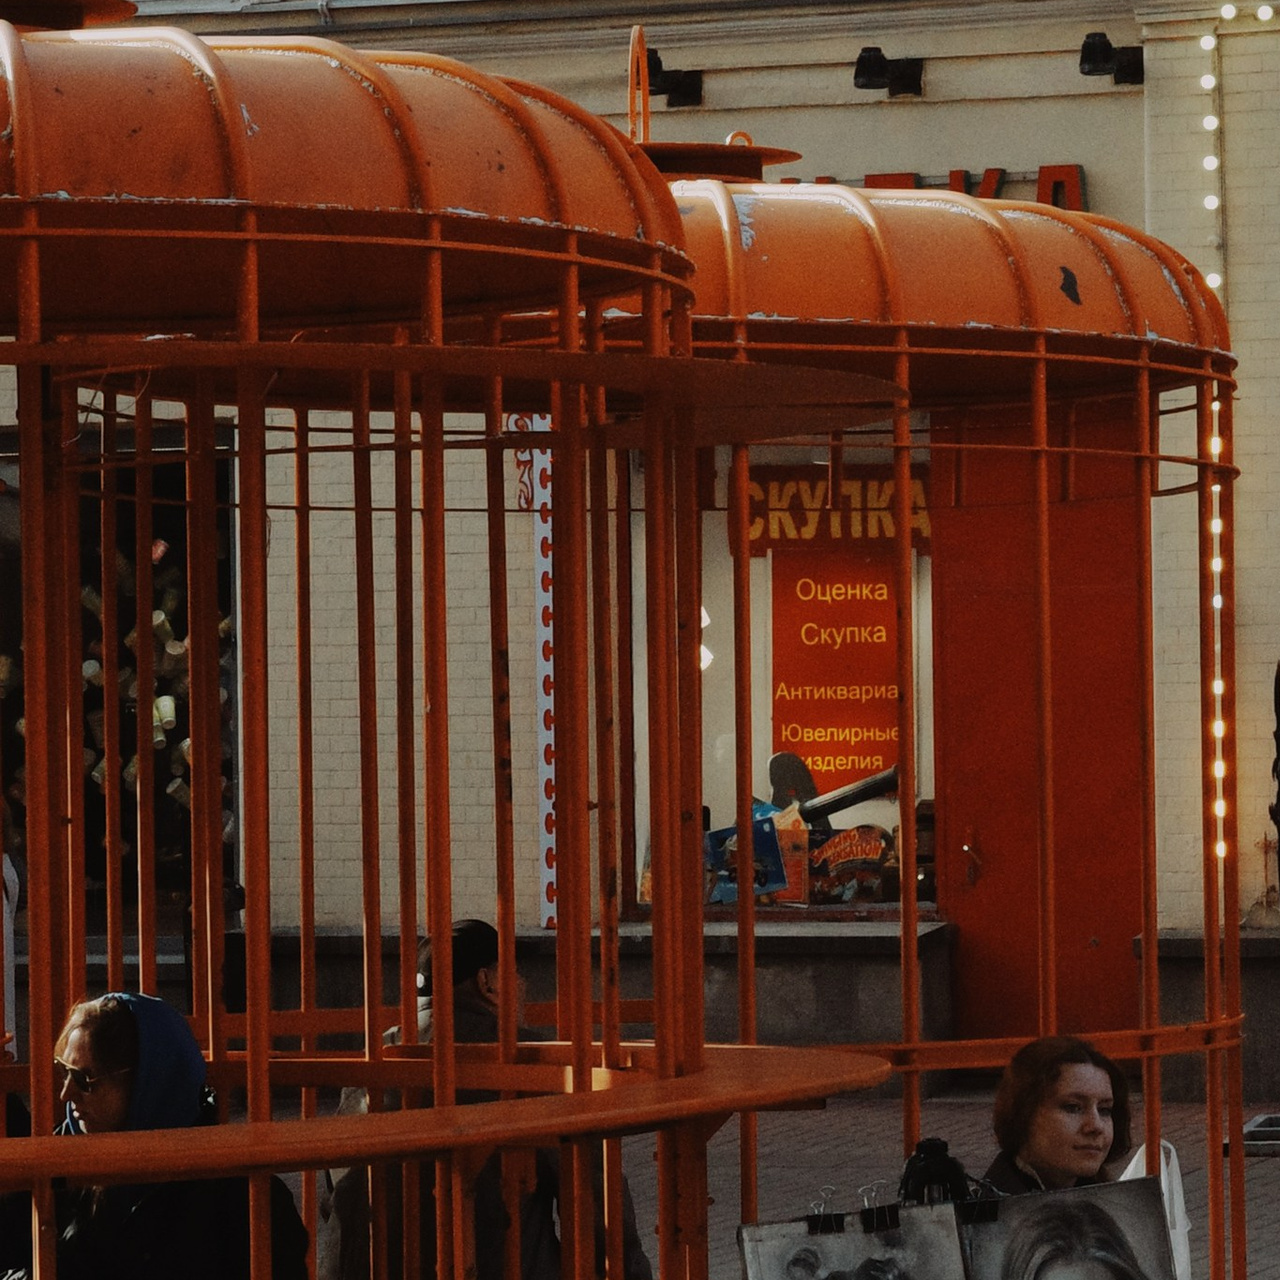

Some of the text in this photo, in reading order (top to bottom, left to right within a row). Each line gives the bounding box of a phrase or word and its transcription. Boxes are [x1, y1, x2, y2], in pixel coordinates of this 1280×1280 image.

[796, 578, 888, 604] Оценка
[801, 622, 887, 650] Скупка
[775, 682, 899, 704] Антиквариа
[781, 724, 899, 746] Ювелирные
[801, 755, 883, 773] изделия
